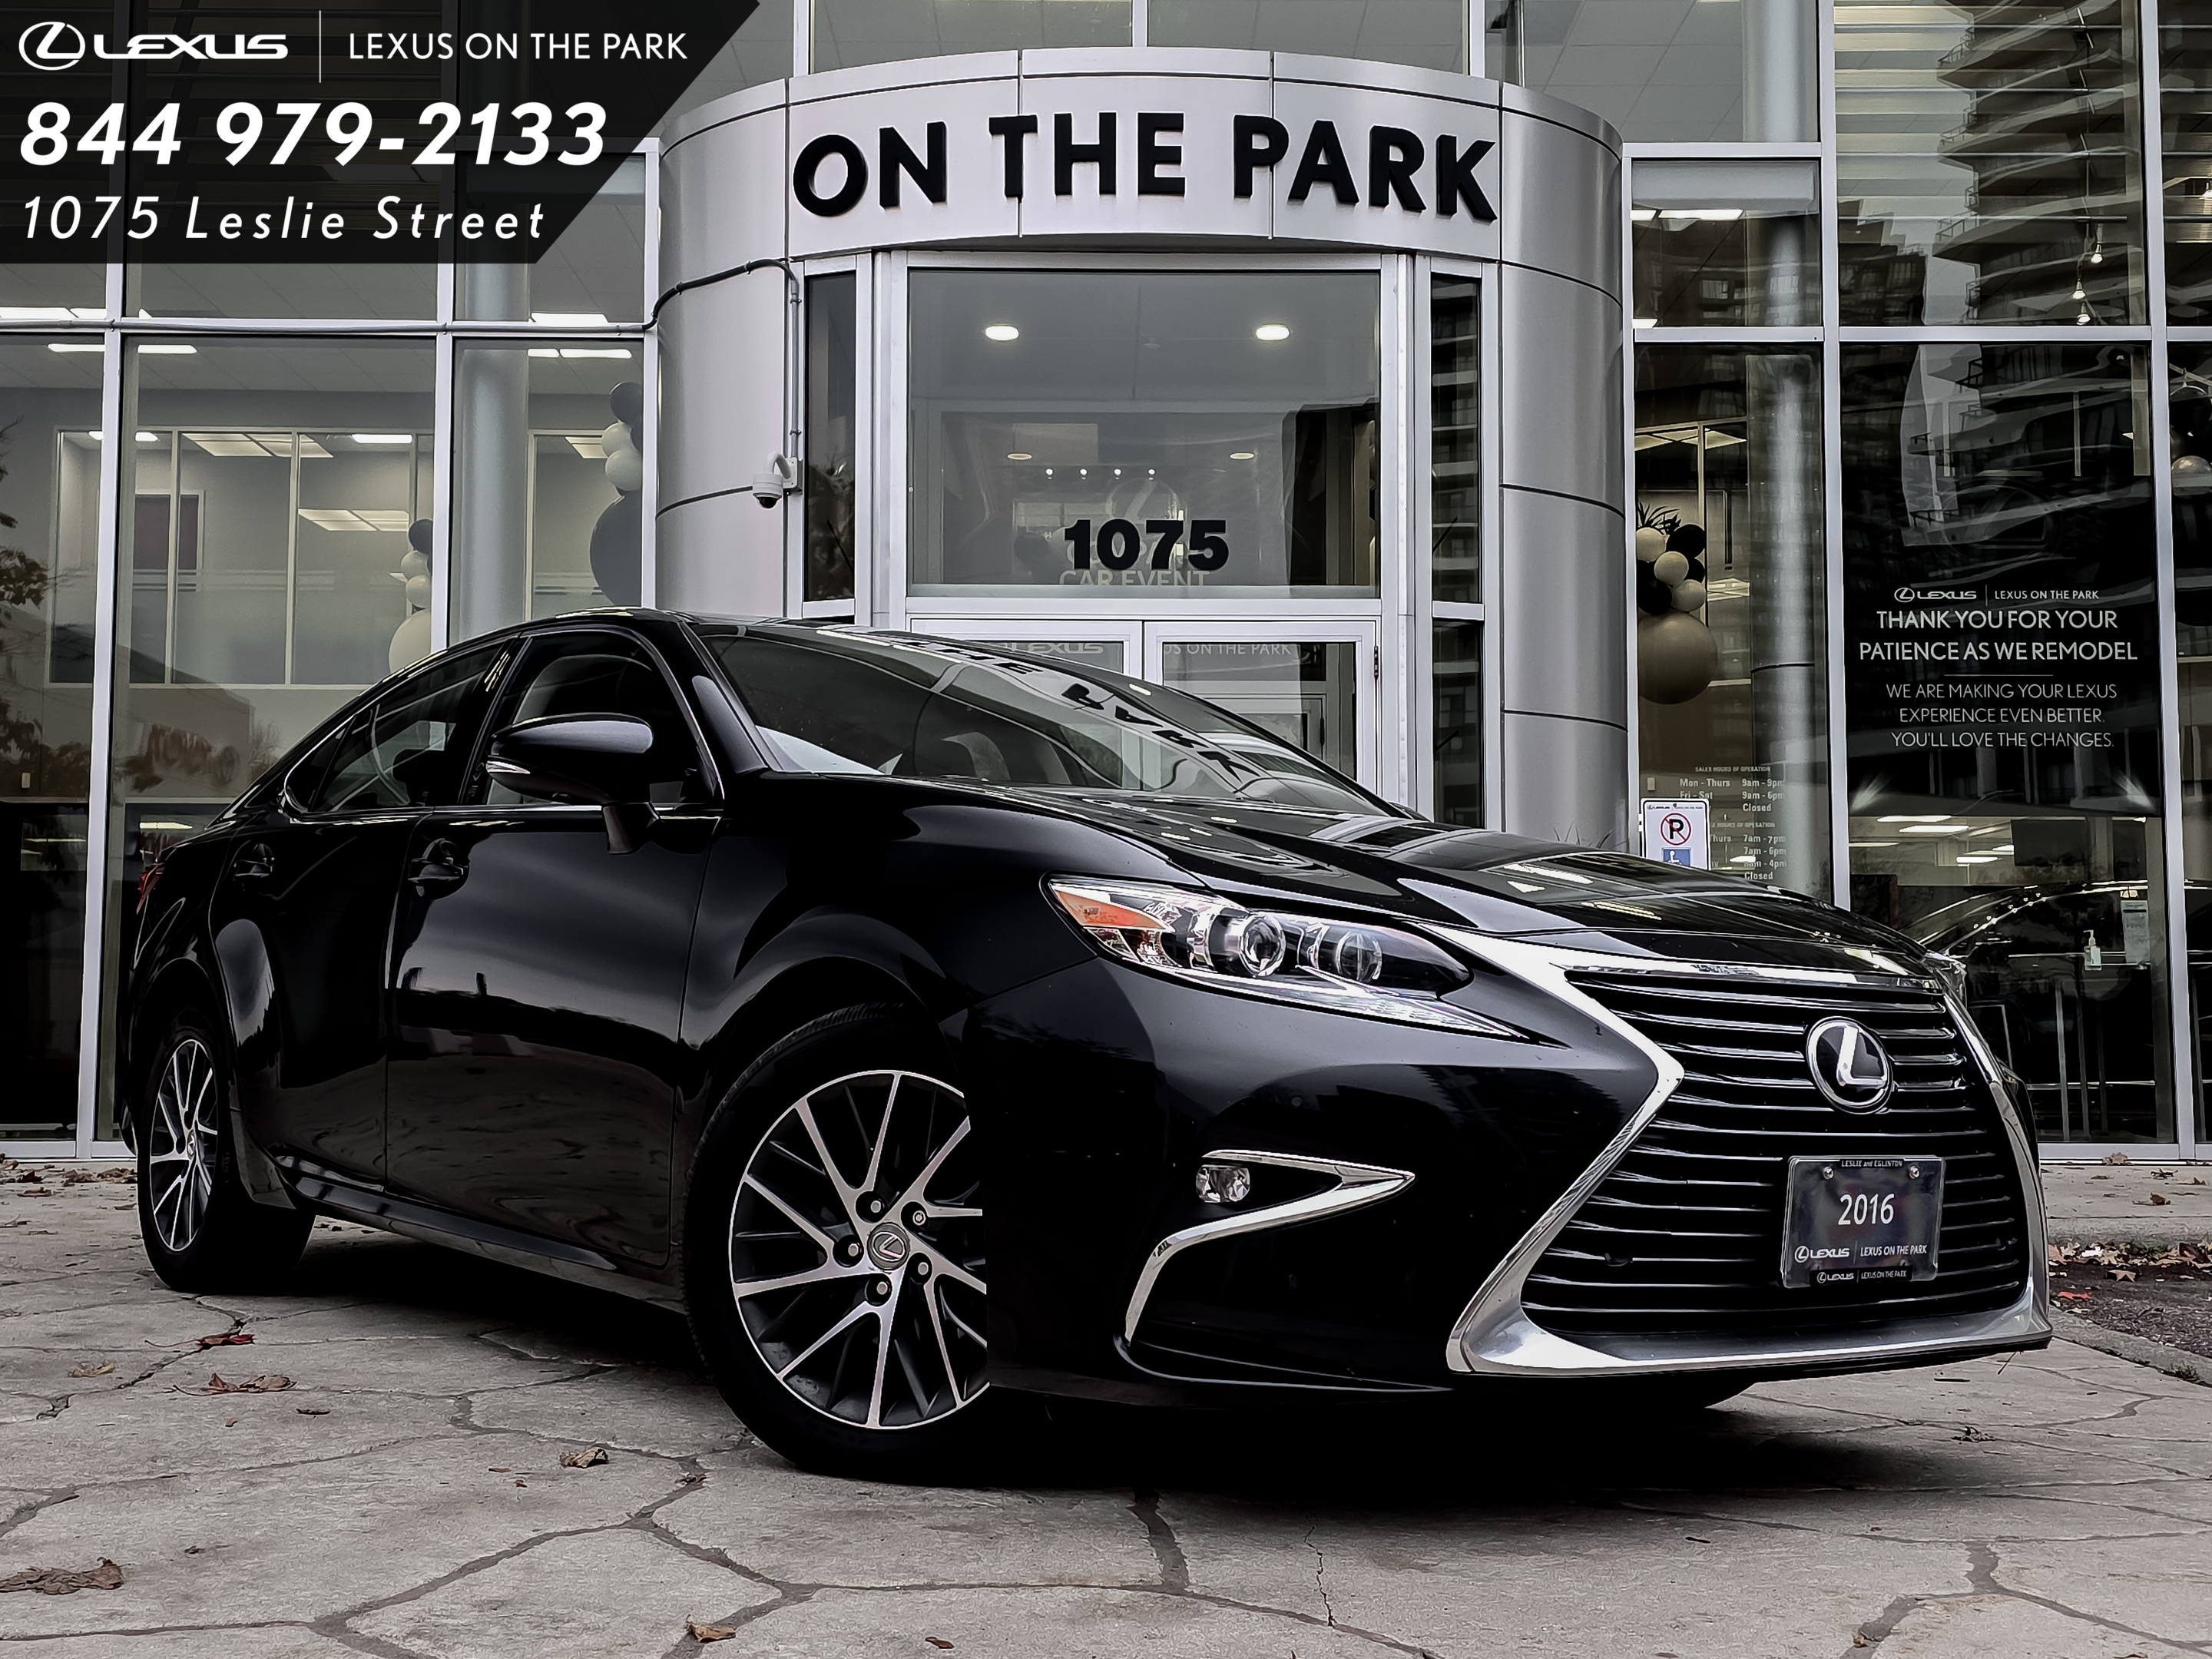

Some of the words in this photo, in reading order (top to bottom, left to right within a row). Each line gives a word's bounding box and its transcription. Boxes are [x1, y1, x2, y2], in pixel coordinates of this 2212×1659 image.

[793, 121, 947, 217] ON
[988, 112, 1186, 199] THE
[1233, 114, 1498, 222] PARK
[1065, 518, 1229, 571] 1075
[1059, 570, 1113, 585] CAR
[1121, 570, 1210, 585] EVENT
[1917, 590, 1977, 600] LEXUS
[1995, 590, 2028, 600] LEXUS
[2030, 591, 2048, 599] ON
[2050, 590, 2070, 600] THE
[2072, 590, 2100, 600] PARK
[1876, 610, 1951, 629] THANK
[1954, 610, 2003, 629] YOU
[2008, 610, 2051, 629] FOR
[2055, 610, 2118, 629] YOUR
[1187, 644, 1211, 654] ON
[1251, 644, 1291, 655] PARK
[1859, 641, 1959, 661] PATIENCE
[1962, 641, 1990, 661] AS
[1994, 642, 2028, 661] WE
[2032, 641, 2138, 661] REMODEL
[1886, 684, 1912, 698] WE
[1916, 684, 1945, 698] ARE
[1949, 684, 2015, 698] MAKING
[2018, 684, 2064, 698] YOUR
[2068, 684, 2118, 698] LEXUS
[1899, 708, 1996, 723] EXPERIENCE
[2000, 708, 2043, 723] EVEN
[2047, 708, 2106, 723] BETTER.
[1891, 732, 1949, 747] YOU'LL
[1952, 732, 1994, 747] LOVE
[1997, 732, 2027, 747] THE
[2030, 732, 2114, 747] CHANGES.
[1680, 778, 1698, 786] Mon
[1706, 778, 1730, 786] Thurs
[1741, 778, 1760, 786] 9am
[1767, 778, 1784, 789] 9pm
[1741, 791, 1760, 800] 9am
[1742, 803, 1772, 812] Closed
[1743, 834, 1761, 843] 7am
[1743, 846, 1761, 855] 7am
[1769, 846, 1786, 857] 6pm
[1769, 859, 1786, 869] 4pm
[1744, 871, 1773, 880] Closed
[1838, 1194, 1895, 1225] 2016
[1810, 1247, 1850, 1259] LEXUS
[1860, 1246, 1883, 1257] LEXUS
[1883, 1245, 1895, 1256] ON
[1896, 1245, 1909, 1255] THE
[1909, 1244, 1928, 1255] PARK
[1826, 1272, 1854, 1281] LEXUS
[1860, 1270, 1877, 1280] LEXUS
[1876, 1270, 1885, 1279] ON
[1885, 1270, 1894, 1278] THE
[1894, 1270, 1907, 1278] PARK
